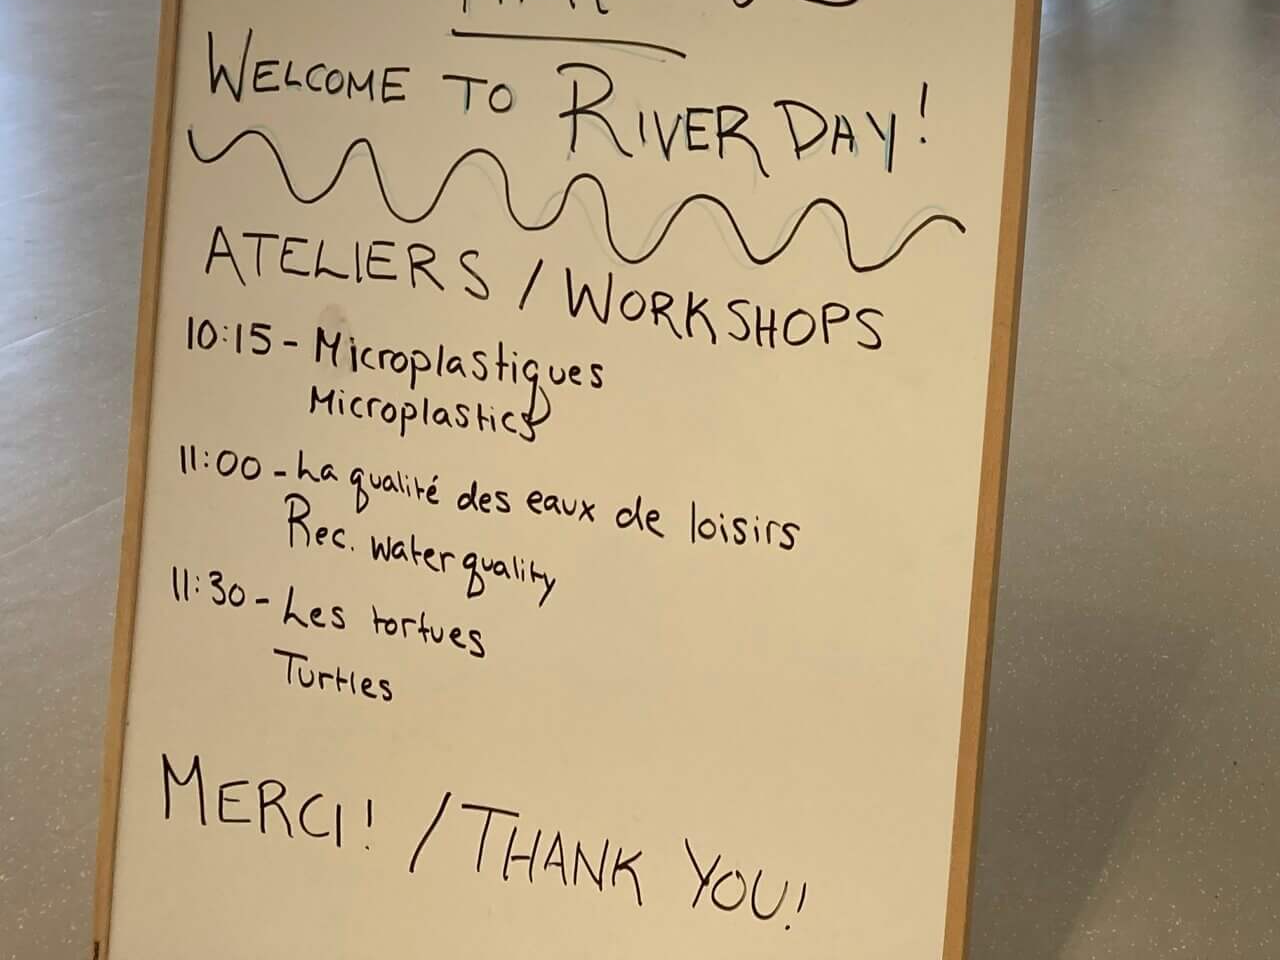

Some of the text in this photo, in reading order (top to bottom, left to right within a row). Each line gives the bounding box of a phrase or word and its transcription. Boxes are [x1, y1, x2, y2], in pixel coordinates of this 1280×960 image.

[207, 27, 929, 179] WELCOME TO RIVER DAY!
[204, 225, 490, 301] ATELIERS
[309, 384, 538, 443] Microplastics
[313, 326, 604, 426] Microplastiques
[297, 449, 339, 483] La
[349, 467, 440, 515] qualité
[456, 479, 511, 514] des
[525, 489, 596, 523] eaux
[615, 495, 665, 539] de
[691, 500, 801, 551] loisirs
[284, 493, 356, 553] Rec.
[462, 551, 557, 609] quality
[282, 585, 346, 630] Les
[371, 604, 486, 659] tortues
[273, 647, 393, 702] Turtles
[684, 837, 807, 931] YOU!
